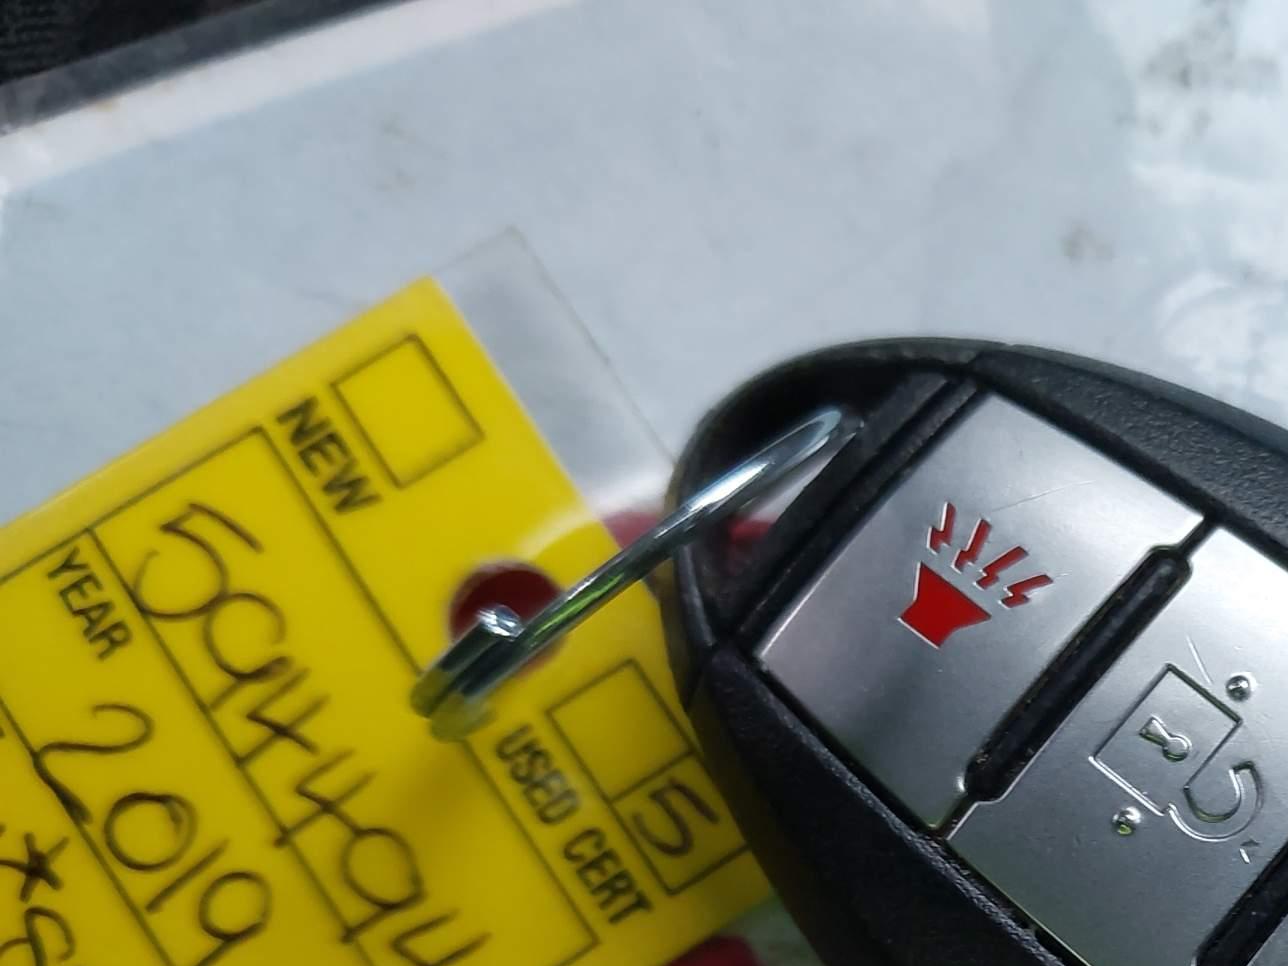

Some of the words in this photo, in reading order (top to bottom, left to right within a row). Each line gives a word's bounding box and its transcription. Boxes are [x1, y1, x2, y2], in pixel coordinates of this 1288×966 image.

[277, 396, 383, 516] NEW
[45, 547, 132, 660] YEAR
[496, 723, 583, 827] USED
[562, 827, 654, 924] CERT
